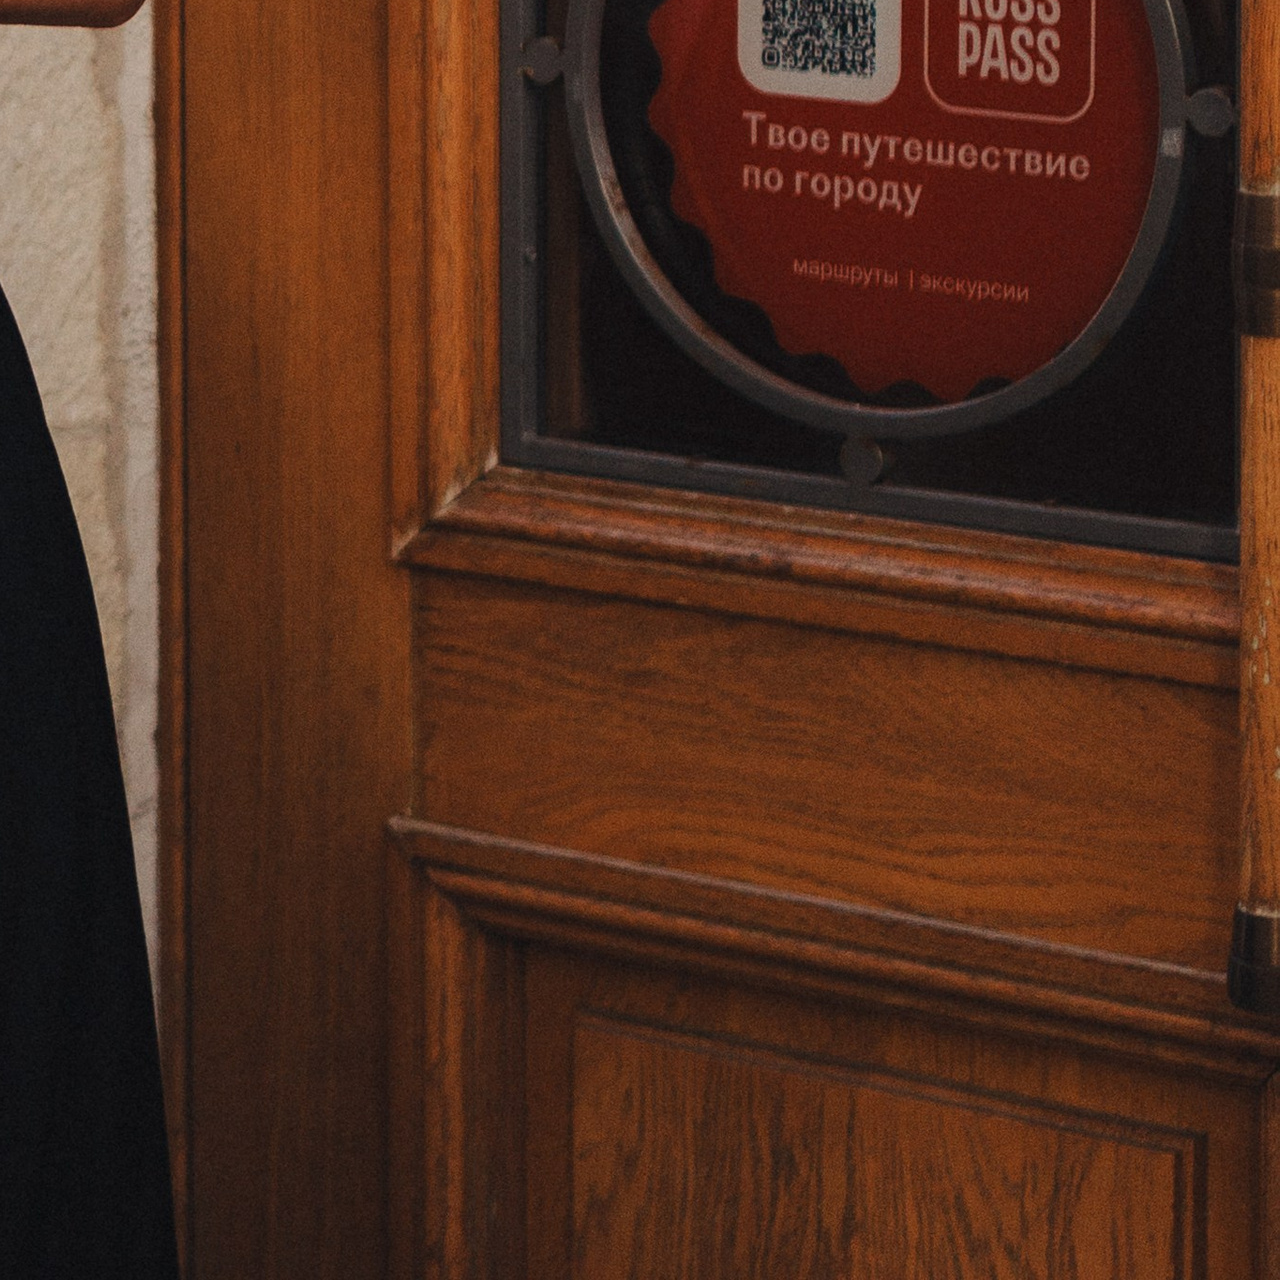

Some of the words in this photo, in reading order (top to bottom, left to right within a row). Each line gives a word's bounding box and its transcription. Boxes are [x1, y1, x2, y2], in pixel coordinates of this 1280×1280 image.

[958, 21, 1060, 85] PASS
[742, 110, 831, 155] Твое
[841, 131, 1091, 182] путешествие
[742, 164, 784, 193] по
[794, 169, 923, 218] городу
[793, 257, 899, 287] маршруты
[919, 272, 1030, 303] экскурсии
